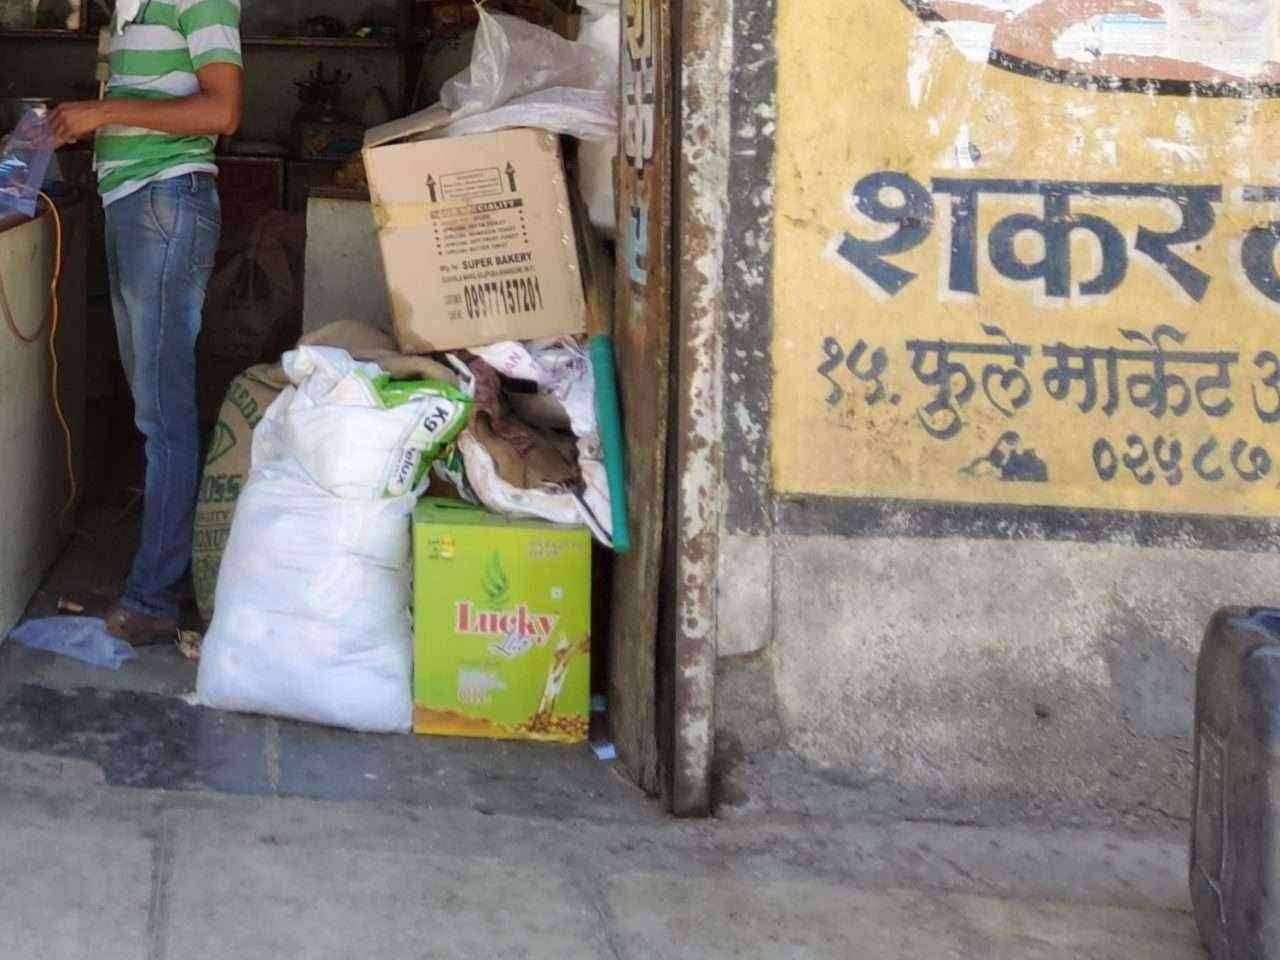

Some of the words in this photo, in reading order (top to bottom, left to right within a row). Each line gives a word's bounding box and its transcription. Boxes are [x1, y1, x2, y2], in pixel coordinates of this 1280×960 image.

[462, 258, 493, 271] SUPER
[495, 251, 533, 266] BAKERY
[905, 323, 1032, 440] फुले
[456, 601, 559, 645] Lucky
